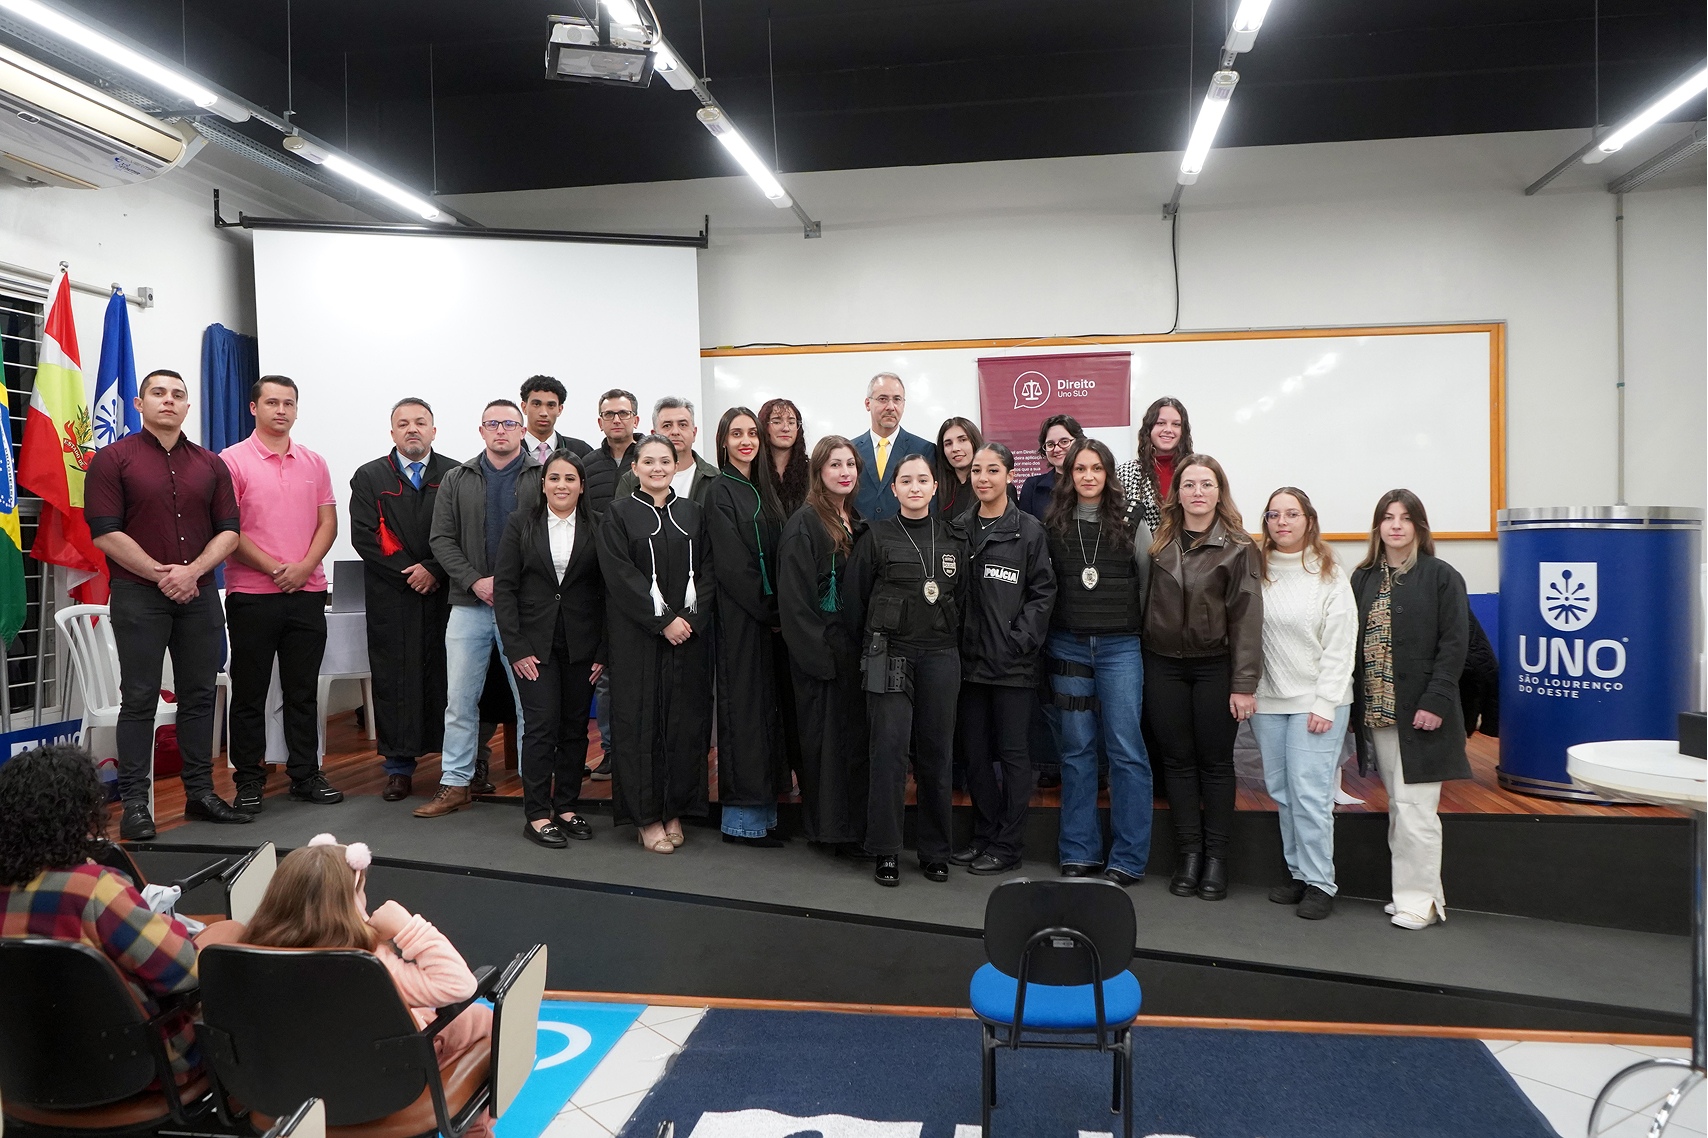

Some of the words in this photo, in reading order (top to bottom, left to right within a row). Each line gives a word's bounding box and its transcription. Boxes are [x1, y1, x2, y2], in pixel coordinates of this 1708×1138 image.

[1057, 379, 1096, 390] Direito
[1057, 390, 1072, 398] Uno
[1073, 389, 1088, 397] SLO
[63, 439, 80, 459] ESTADO
[985, 566, 1017, 582] POLÍCIA
[1519, 634, 1626, 678] UNO
[1518, 674, 1540, 684] SÃO
[1544, 678, 1624, 692] LOURENÇO
[1518, 684, 1533, 693] DO
[1537, 687, 1580, 699] OESTE
